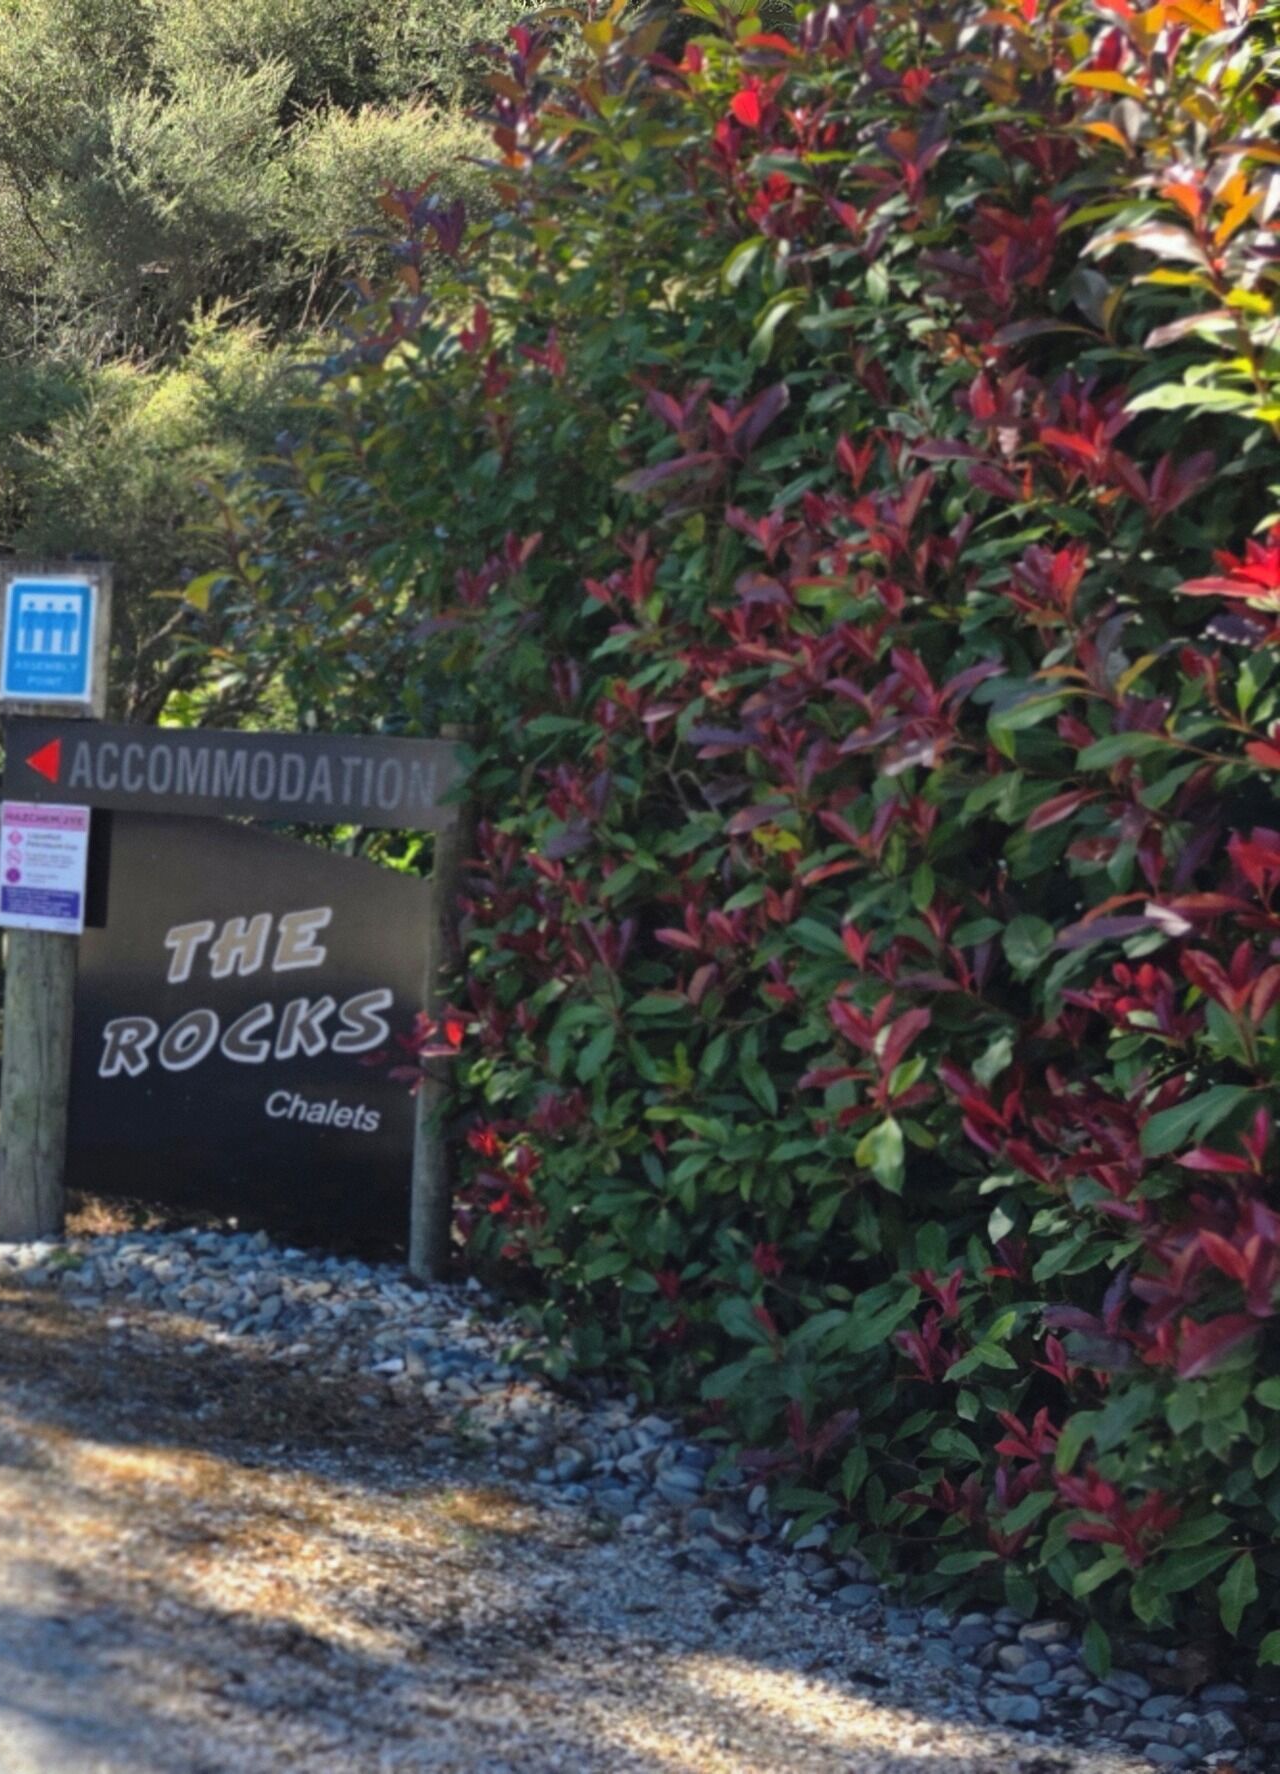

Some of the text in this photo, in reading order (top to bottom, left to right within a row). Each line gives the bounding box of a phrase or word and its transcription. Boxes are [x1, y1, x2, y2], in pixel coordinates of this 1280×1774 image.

[69, 740, 436, 810] ACCOMMODATION
[164, 907, 332, 983] THE
[98, 989, 393, 1078] ROCKS
[264, 1090, 381, 1133] Chalets
